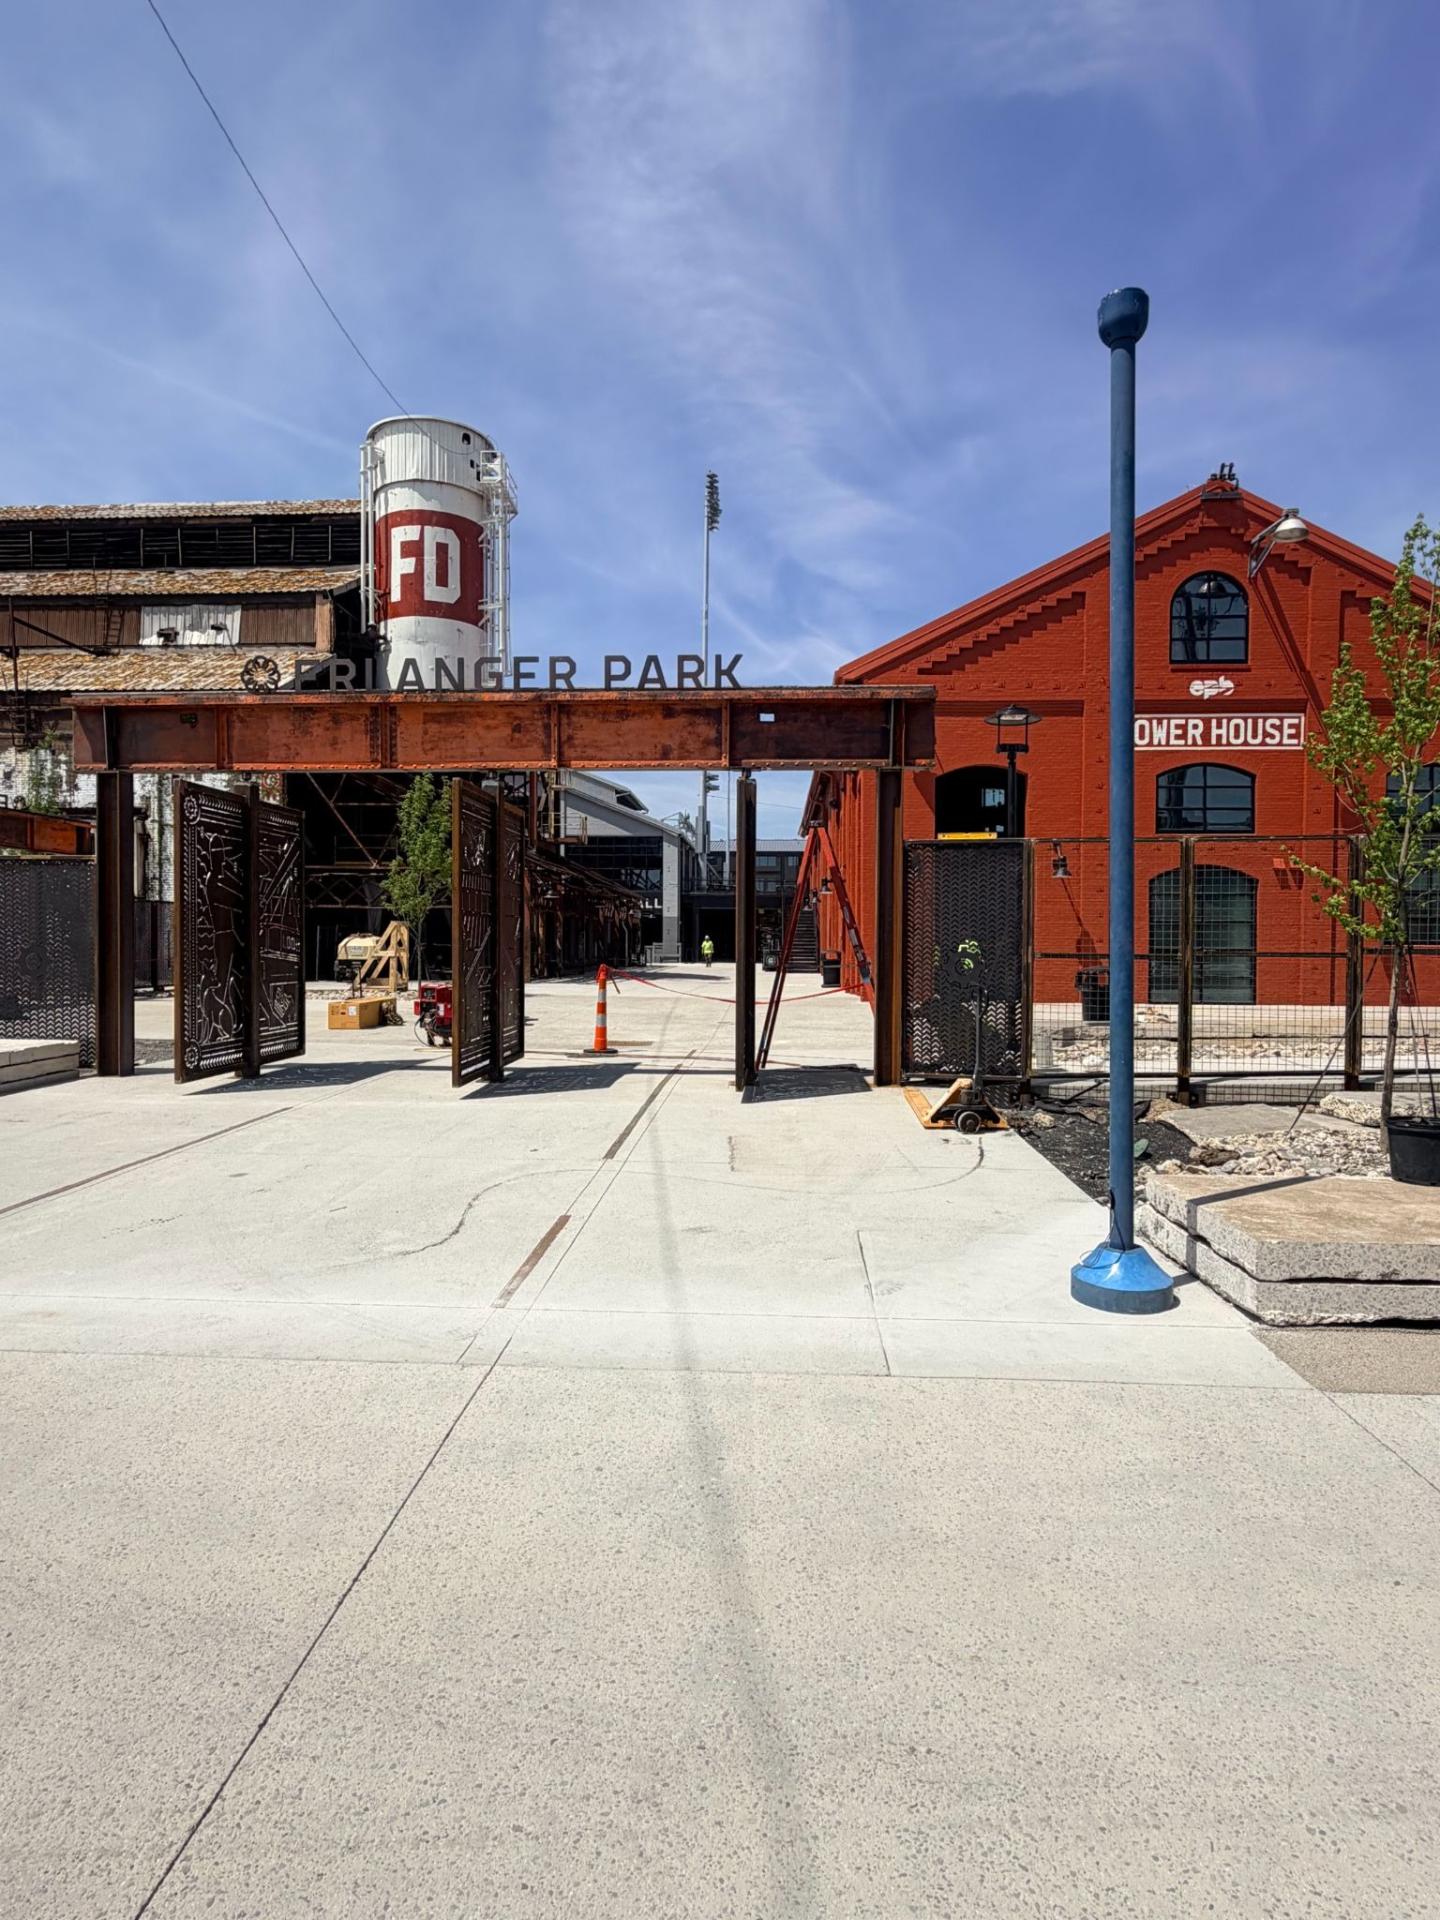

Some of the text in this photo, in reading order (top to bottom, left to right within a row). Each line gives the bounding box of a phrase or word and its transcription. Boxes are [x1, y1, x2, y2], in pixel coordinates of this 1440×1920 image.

[391, 525, 461, 604] FD
[295, 654, 743, 690] ERLANGER PARK
[1134, 718, 1299, 745] OWER HOUSE
